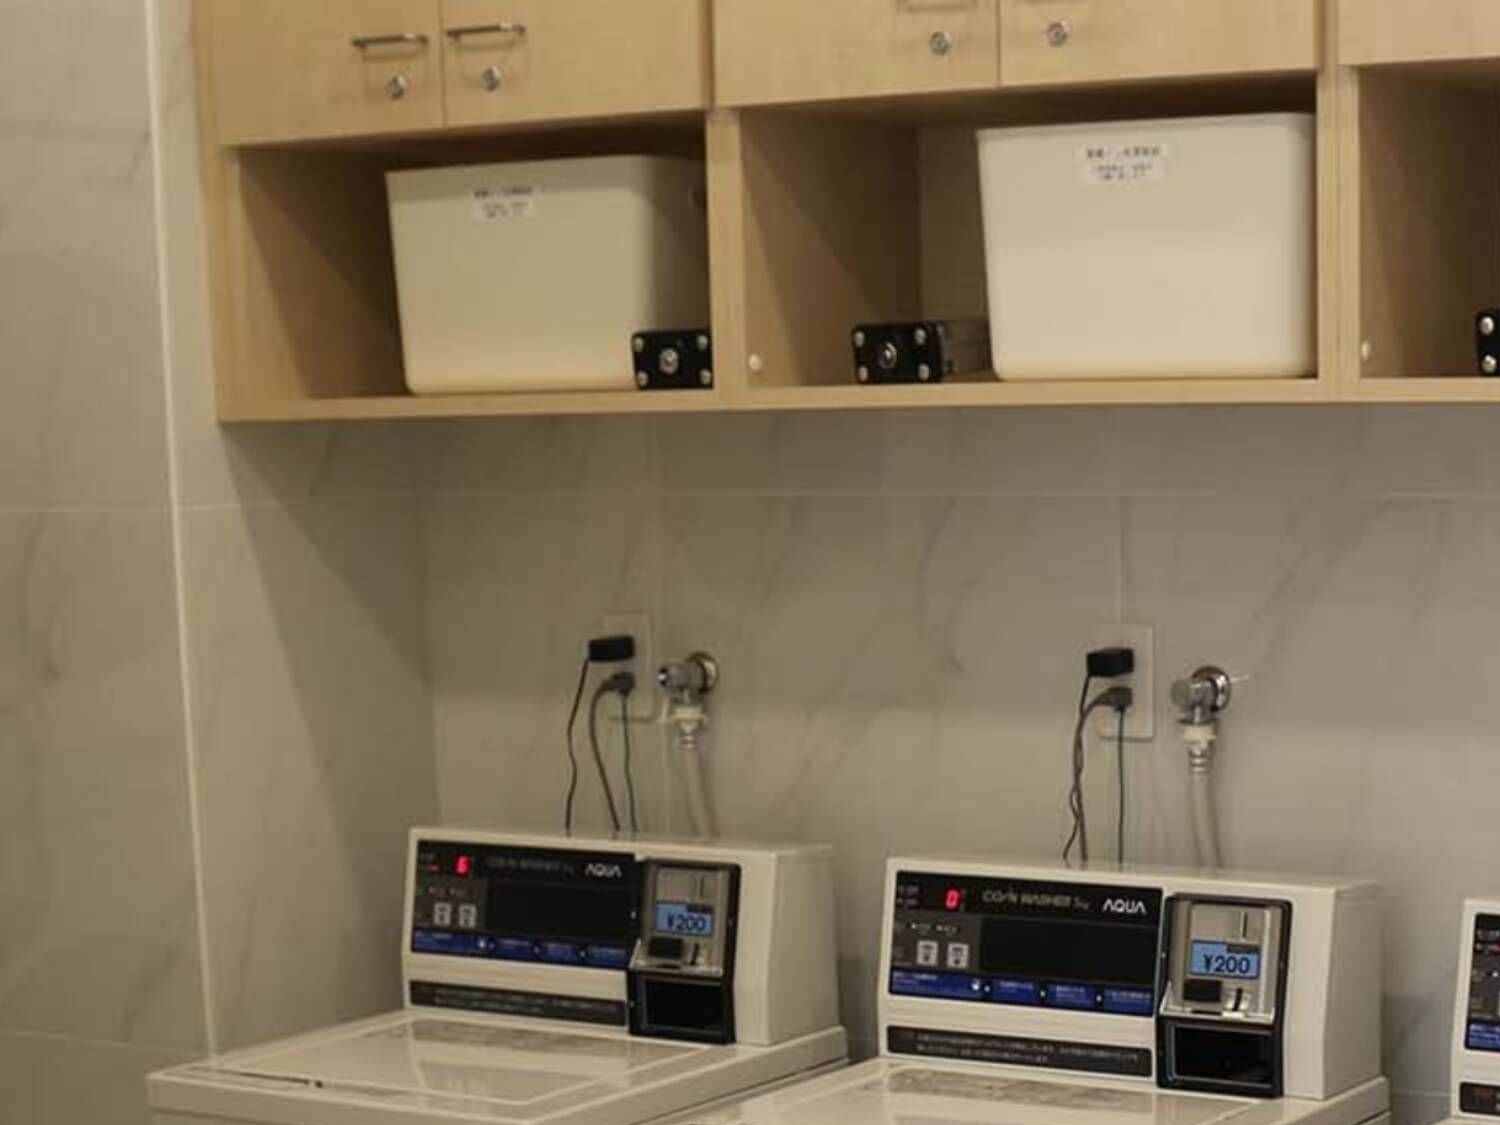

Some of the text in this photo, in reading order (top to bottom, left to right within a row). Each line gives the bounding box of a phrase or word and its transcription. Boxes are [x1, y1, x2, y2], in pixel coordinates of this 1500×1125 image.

[584, 863, 623, 879] AQUA
[945, 888, 961, 910] 0
[1102, 898, 1147, 915] AQUA
[667, 914, 706, 931] ¥200
[1202, 953, 1251, 975] ¥200
